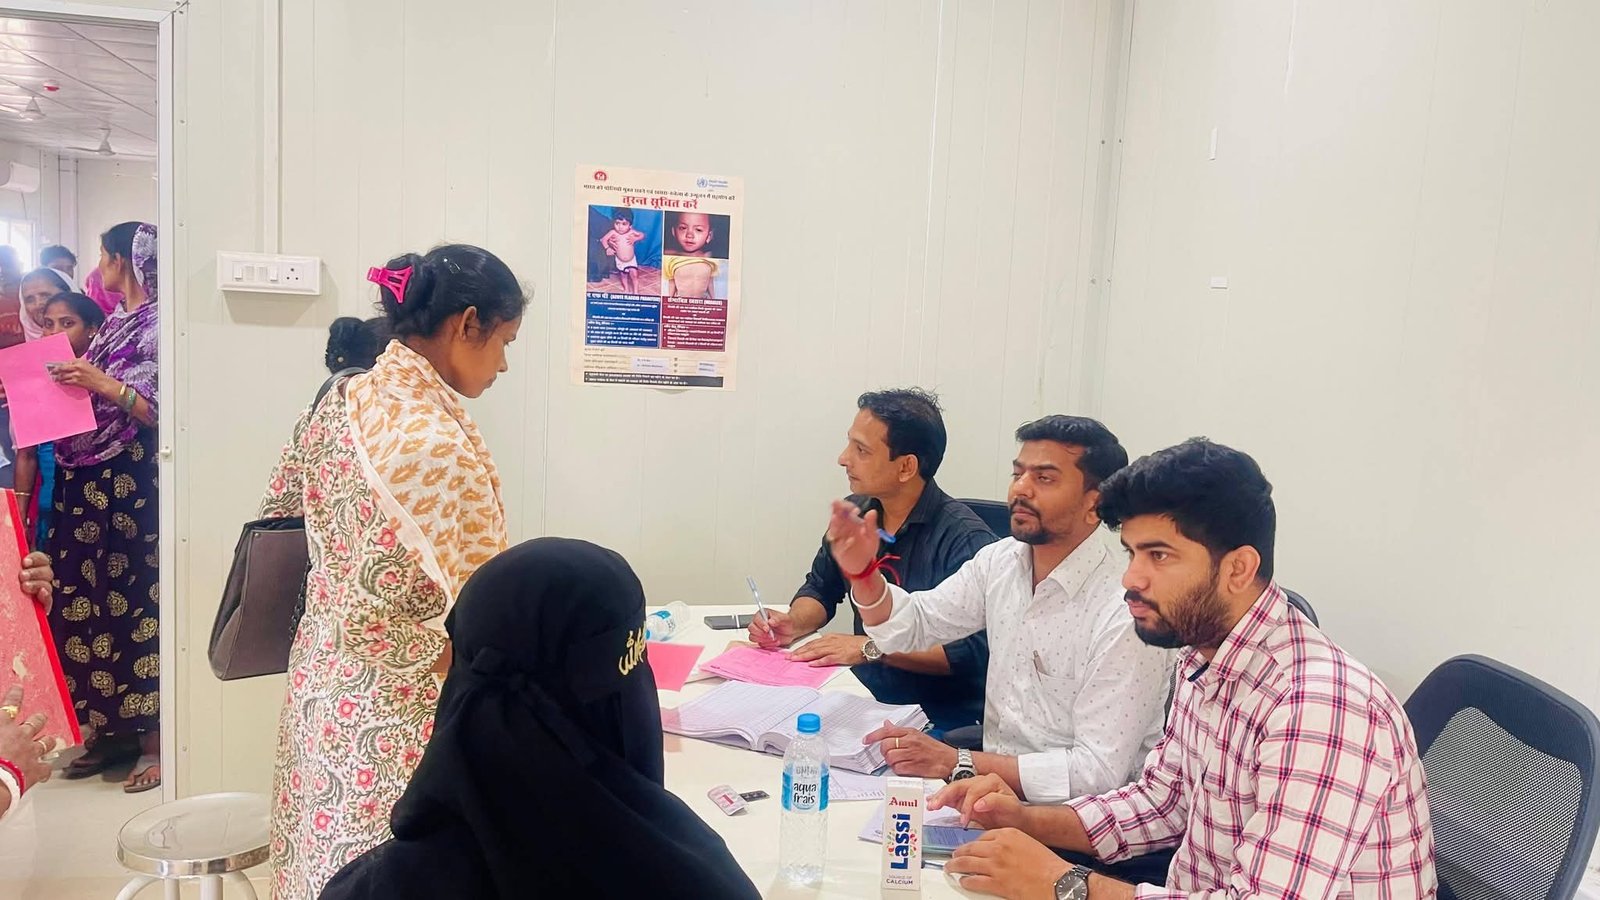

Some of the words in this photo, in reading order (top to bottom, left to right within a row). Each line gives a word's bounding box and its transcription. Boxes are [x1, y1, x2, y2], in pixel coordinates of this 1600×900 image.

[650, 197, 680, 209] सूचित
[683, 198, 698, 209] करें
[794, 783, 817, 795] aqua
[793, 792, 816, 804] frais
[889, 797, 918, 808] Amul
[890, 813, 911, 870] Lassi
